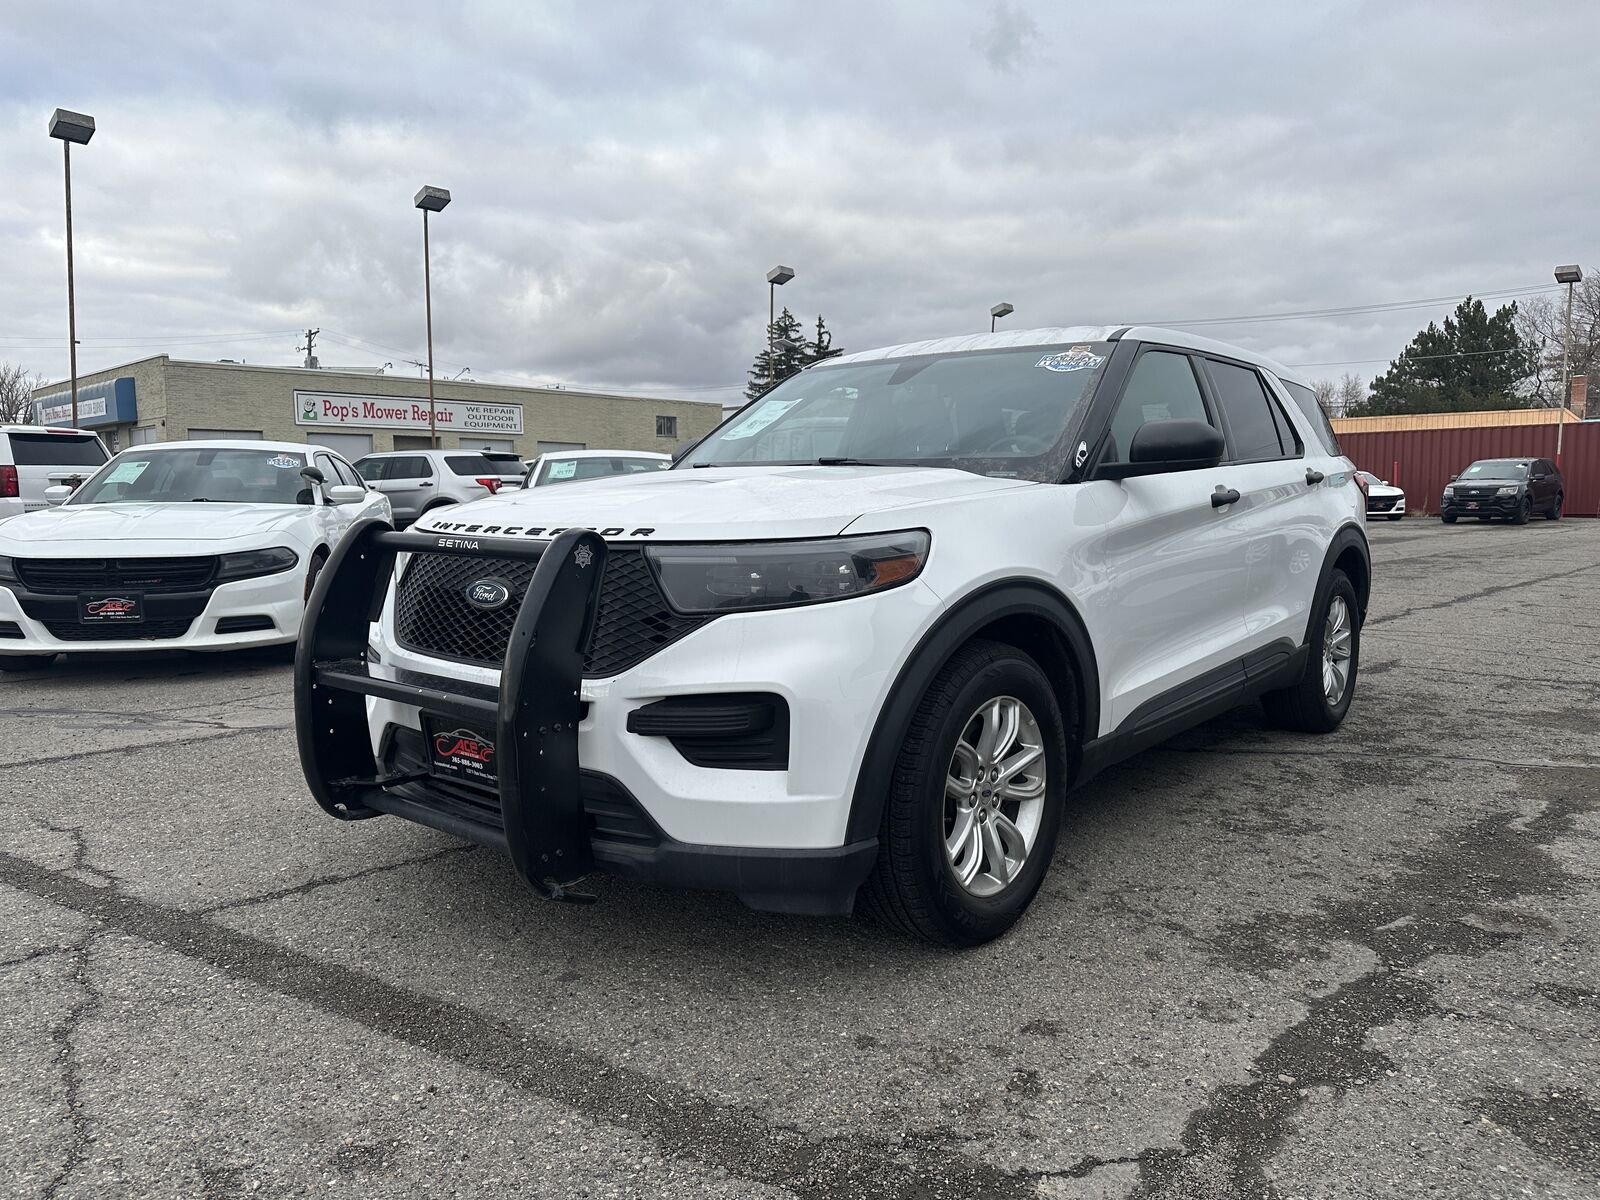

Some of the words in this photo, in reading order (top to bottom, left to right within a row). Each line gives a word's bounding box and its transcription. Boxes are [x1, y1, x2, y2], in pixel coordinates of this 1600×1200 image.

[322, 400, 359, 422] Pop's
[362, 401, 408, 420] Mower
[411, 404, 454, 426] Repair
[466, 406, 481, 414] WE
[483, 407, 515, 415] REPAIR
[467, 413, 514, 422] OUTDOOR
[464, 421, 518, 430] EQUIPMENT
[432, 521, 656, 537] INTERCEPOR
[438, 538, 479, 550] SETINA
[472, 585, 497, 602] Ford
